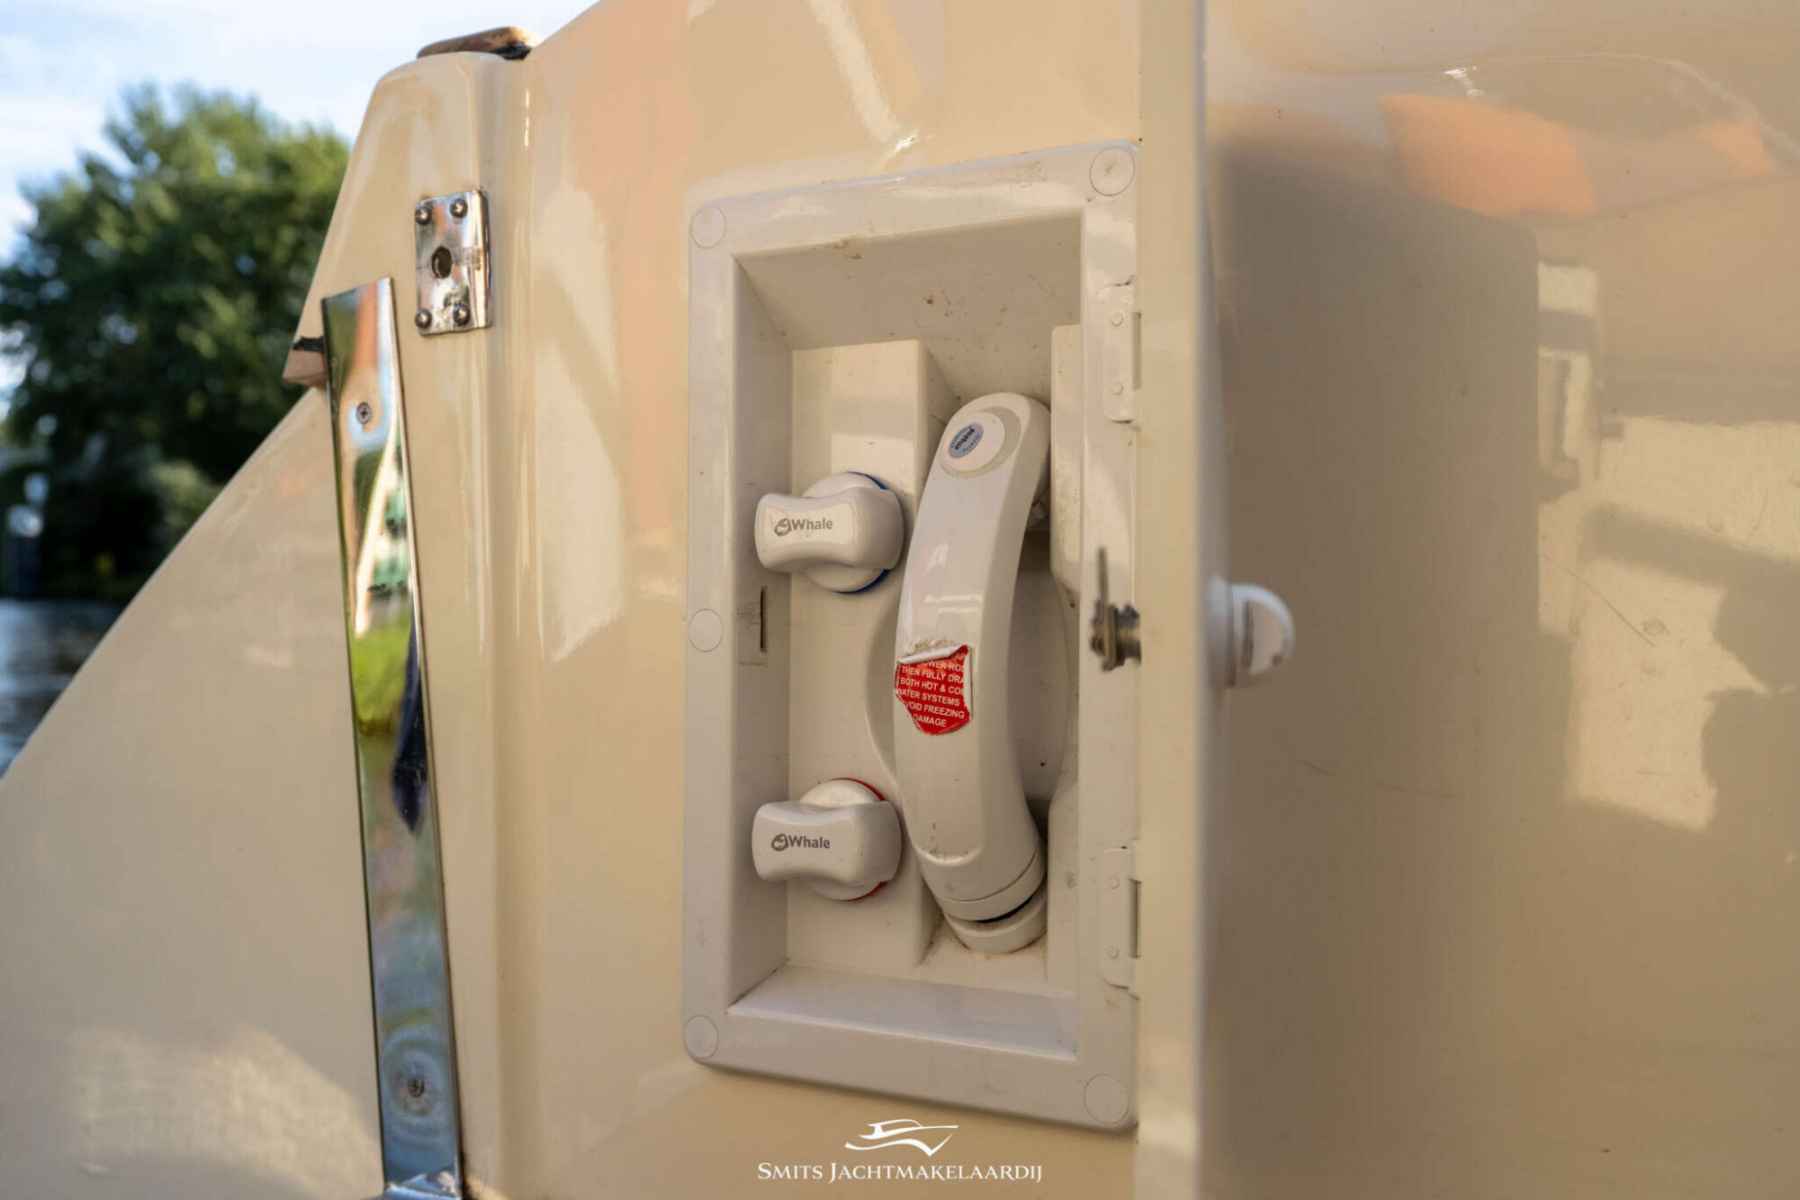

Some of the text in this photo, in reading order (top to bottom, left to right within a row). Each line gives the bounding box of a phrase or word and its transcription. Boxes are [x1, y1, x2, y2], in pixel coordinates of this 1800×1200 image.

[791, 517, 833, 530] Whale
[901, 664, 920, 675] THEN
[921, 669, 946, 680] FULLY
[900, 677, 963, 696] BOTH HOT & CO
[921, 692, 961, 706] SYSTEMS
[923, 704, 965, 719] FREEZING
[788, 834, 831, 848] Whale
